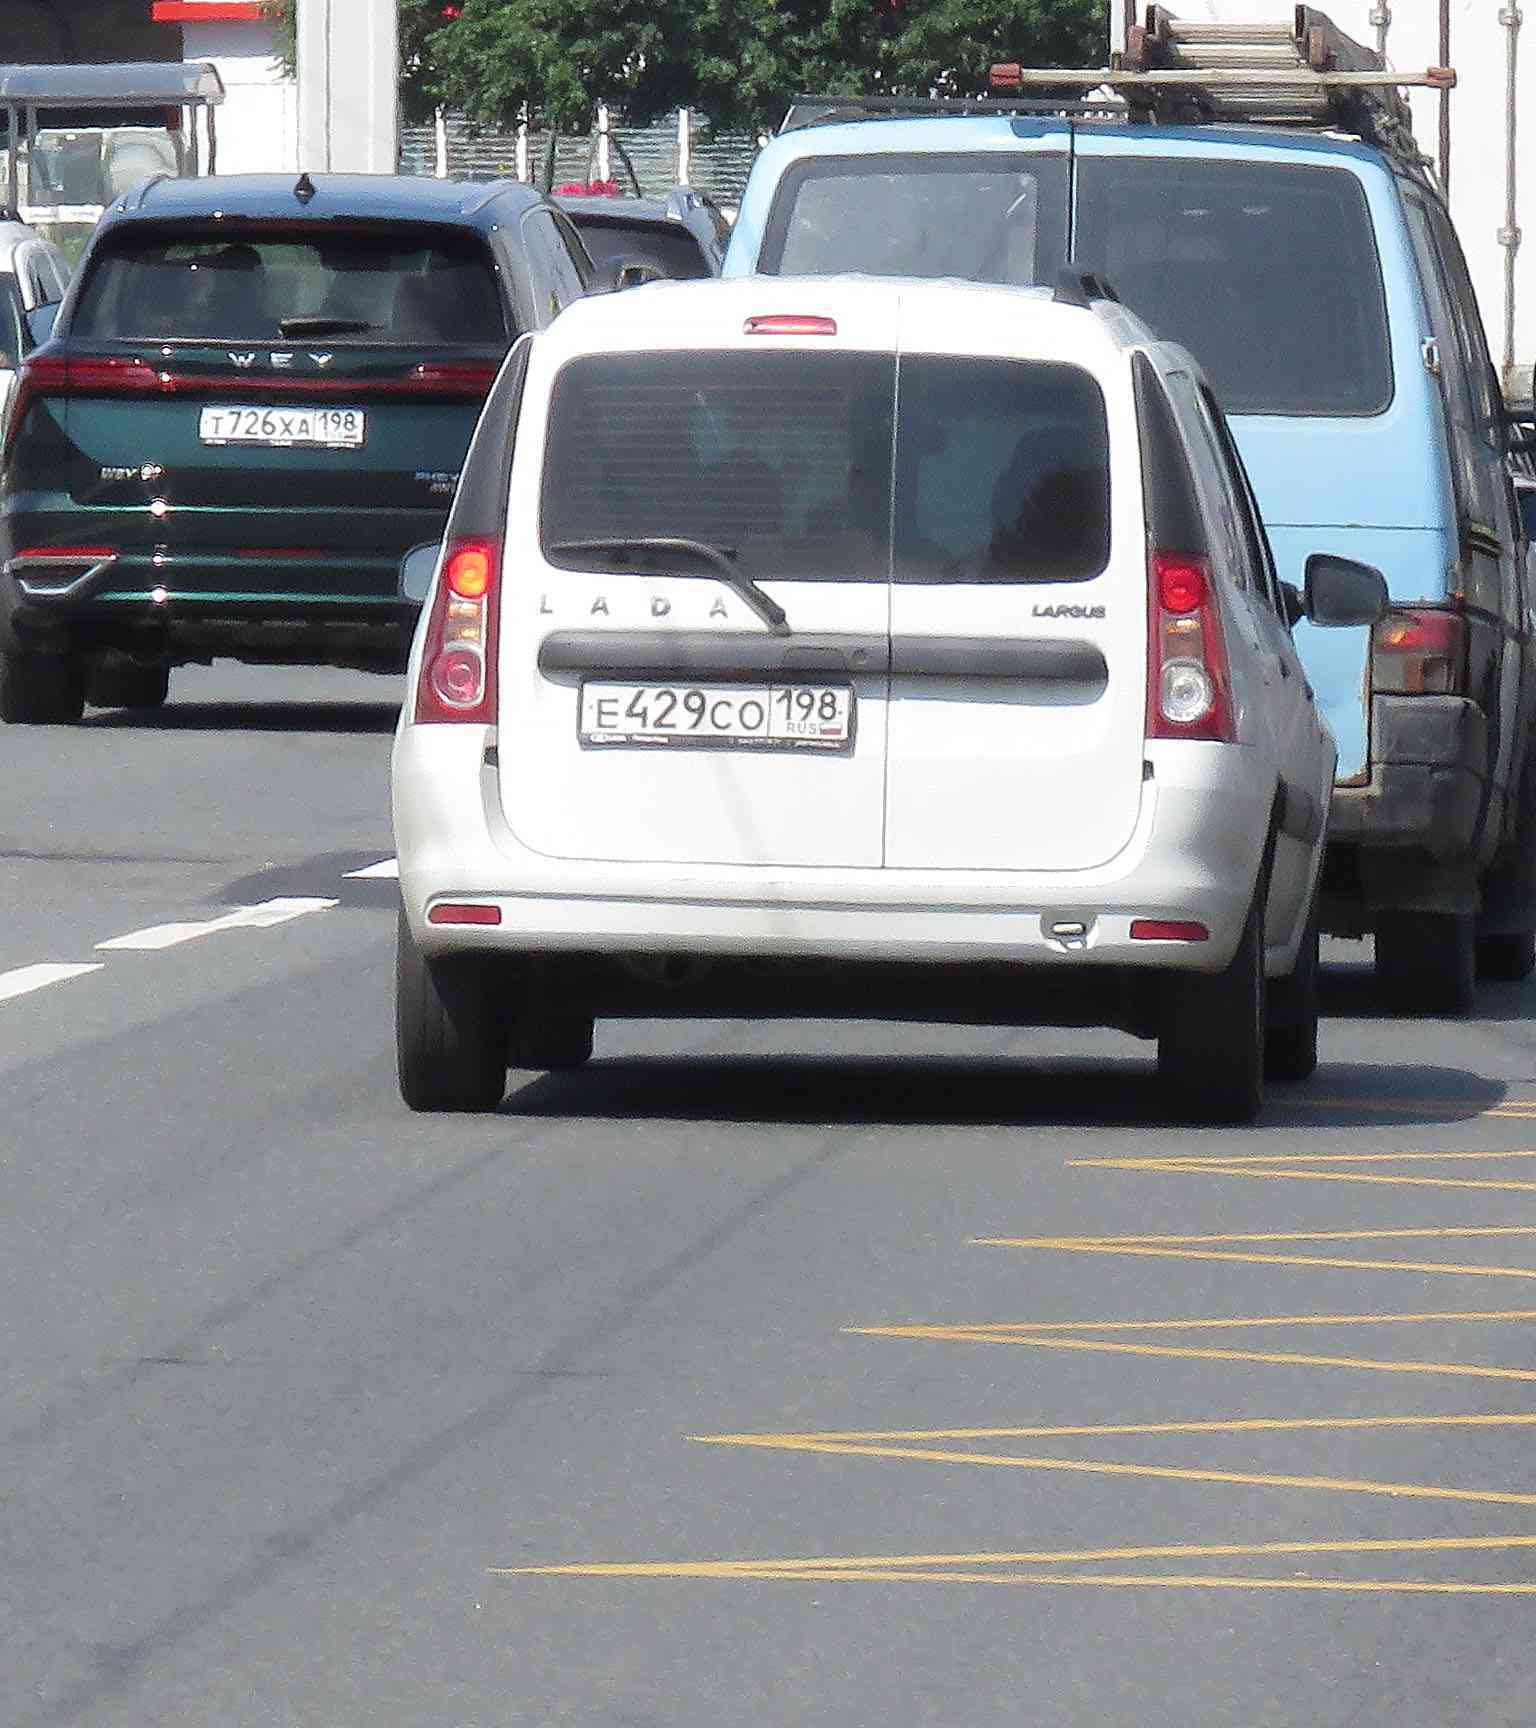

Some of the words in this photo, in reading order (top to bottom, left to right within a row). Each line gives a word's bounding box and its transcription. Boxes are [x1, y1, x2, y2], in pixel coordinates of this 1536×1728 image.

[317, 412, 356, 433] 198
[538, 594, 729, 618] LADA
[1031, 603, 1107, 619] LARGUS
[596, 688, 765, 730] Е429СО
[775, 688, 838, 721] 198
[786, 722, 822, 735] RUS
